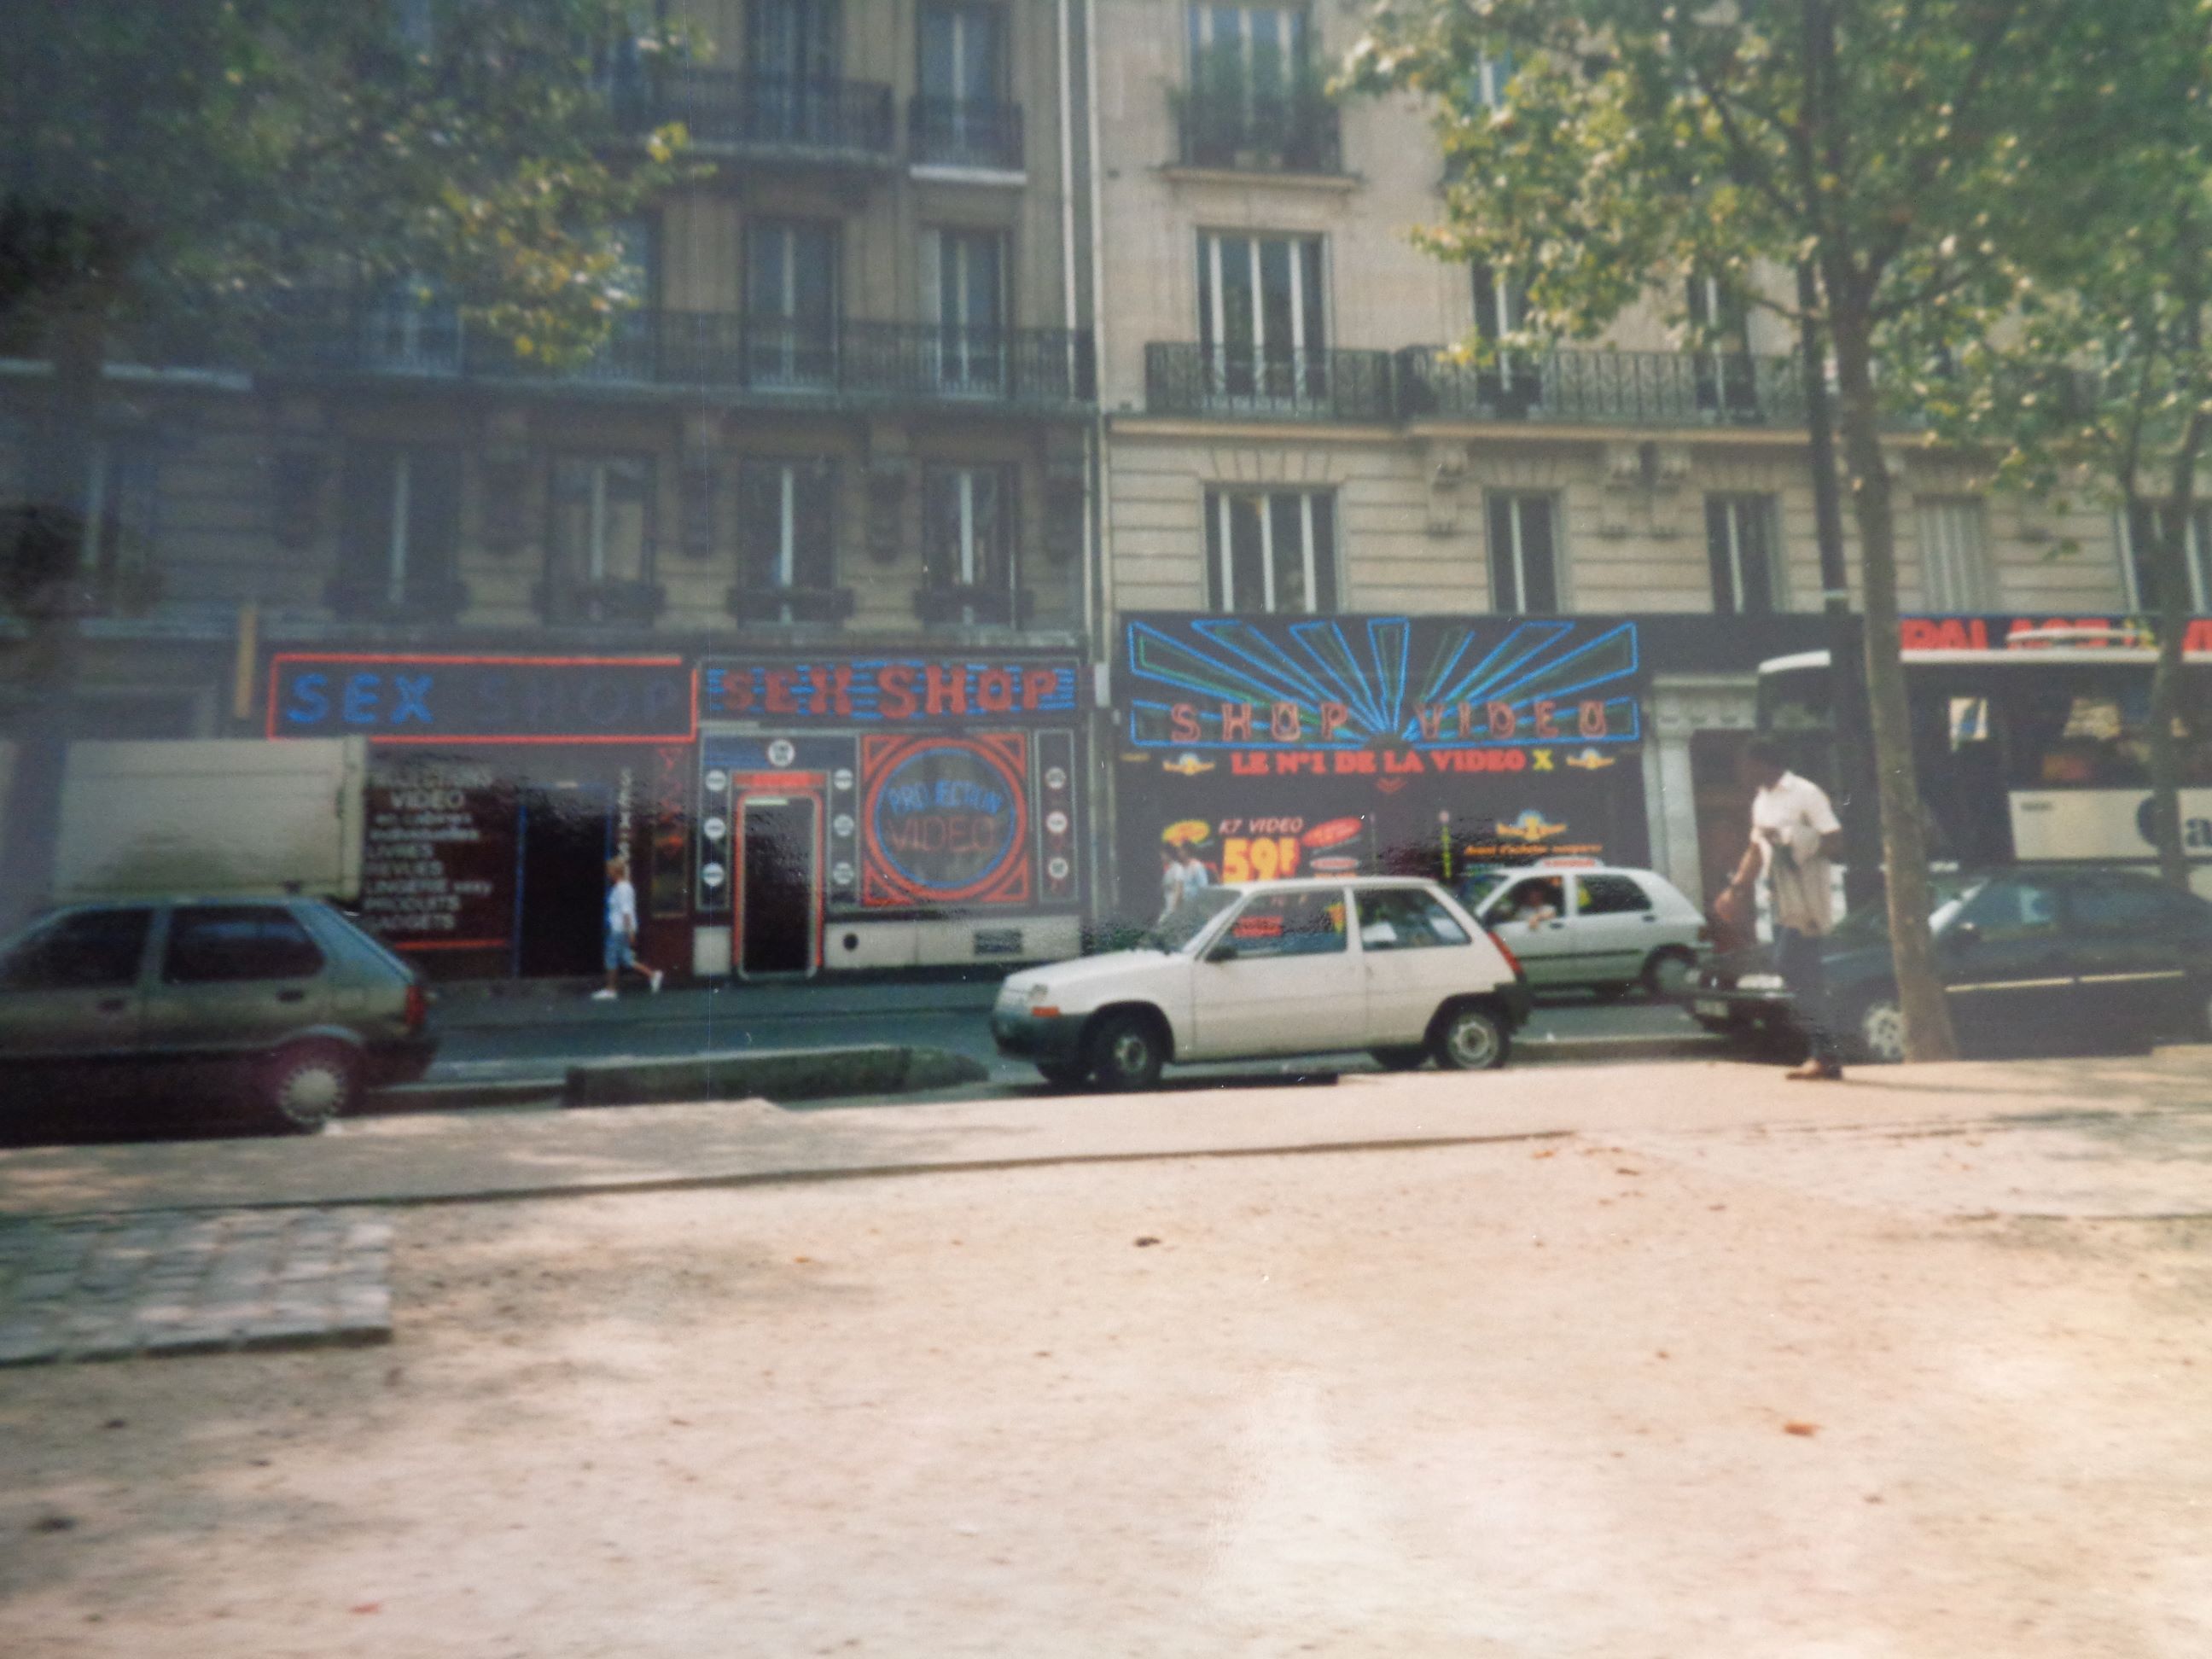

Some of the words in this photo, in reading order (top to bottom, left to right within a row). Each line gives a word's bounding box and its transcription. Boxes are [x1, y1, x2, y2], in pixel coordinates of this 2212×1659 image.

[287, 673, 435, 725] SEX
[720, 667, 853, 715] SEX
[876, 664, 1058, 719] SHOP
[1169, 701, 1349, 742] SHOP
[1417, 700, 1609, 740] VIDEO
[1231, 750, 1270, 776] LE
[1334, 750, 1376, 774] DE
[1382, 749, 1425, 774] LA
[1430, 749, 1527, 773] VIDEO
[1533, 749, 1554, 771] X
[389, 790, 466, 810] VIDEO
[886, 814, 997, 853] VIDEO
[1218, 818, 1243, 835] K7
[1249, 816, 1305, 835] VIDEO
